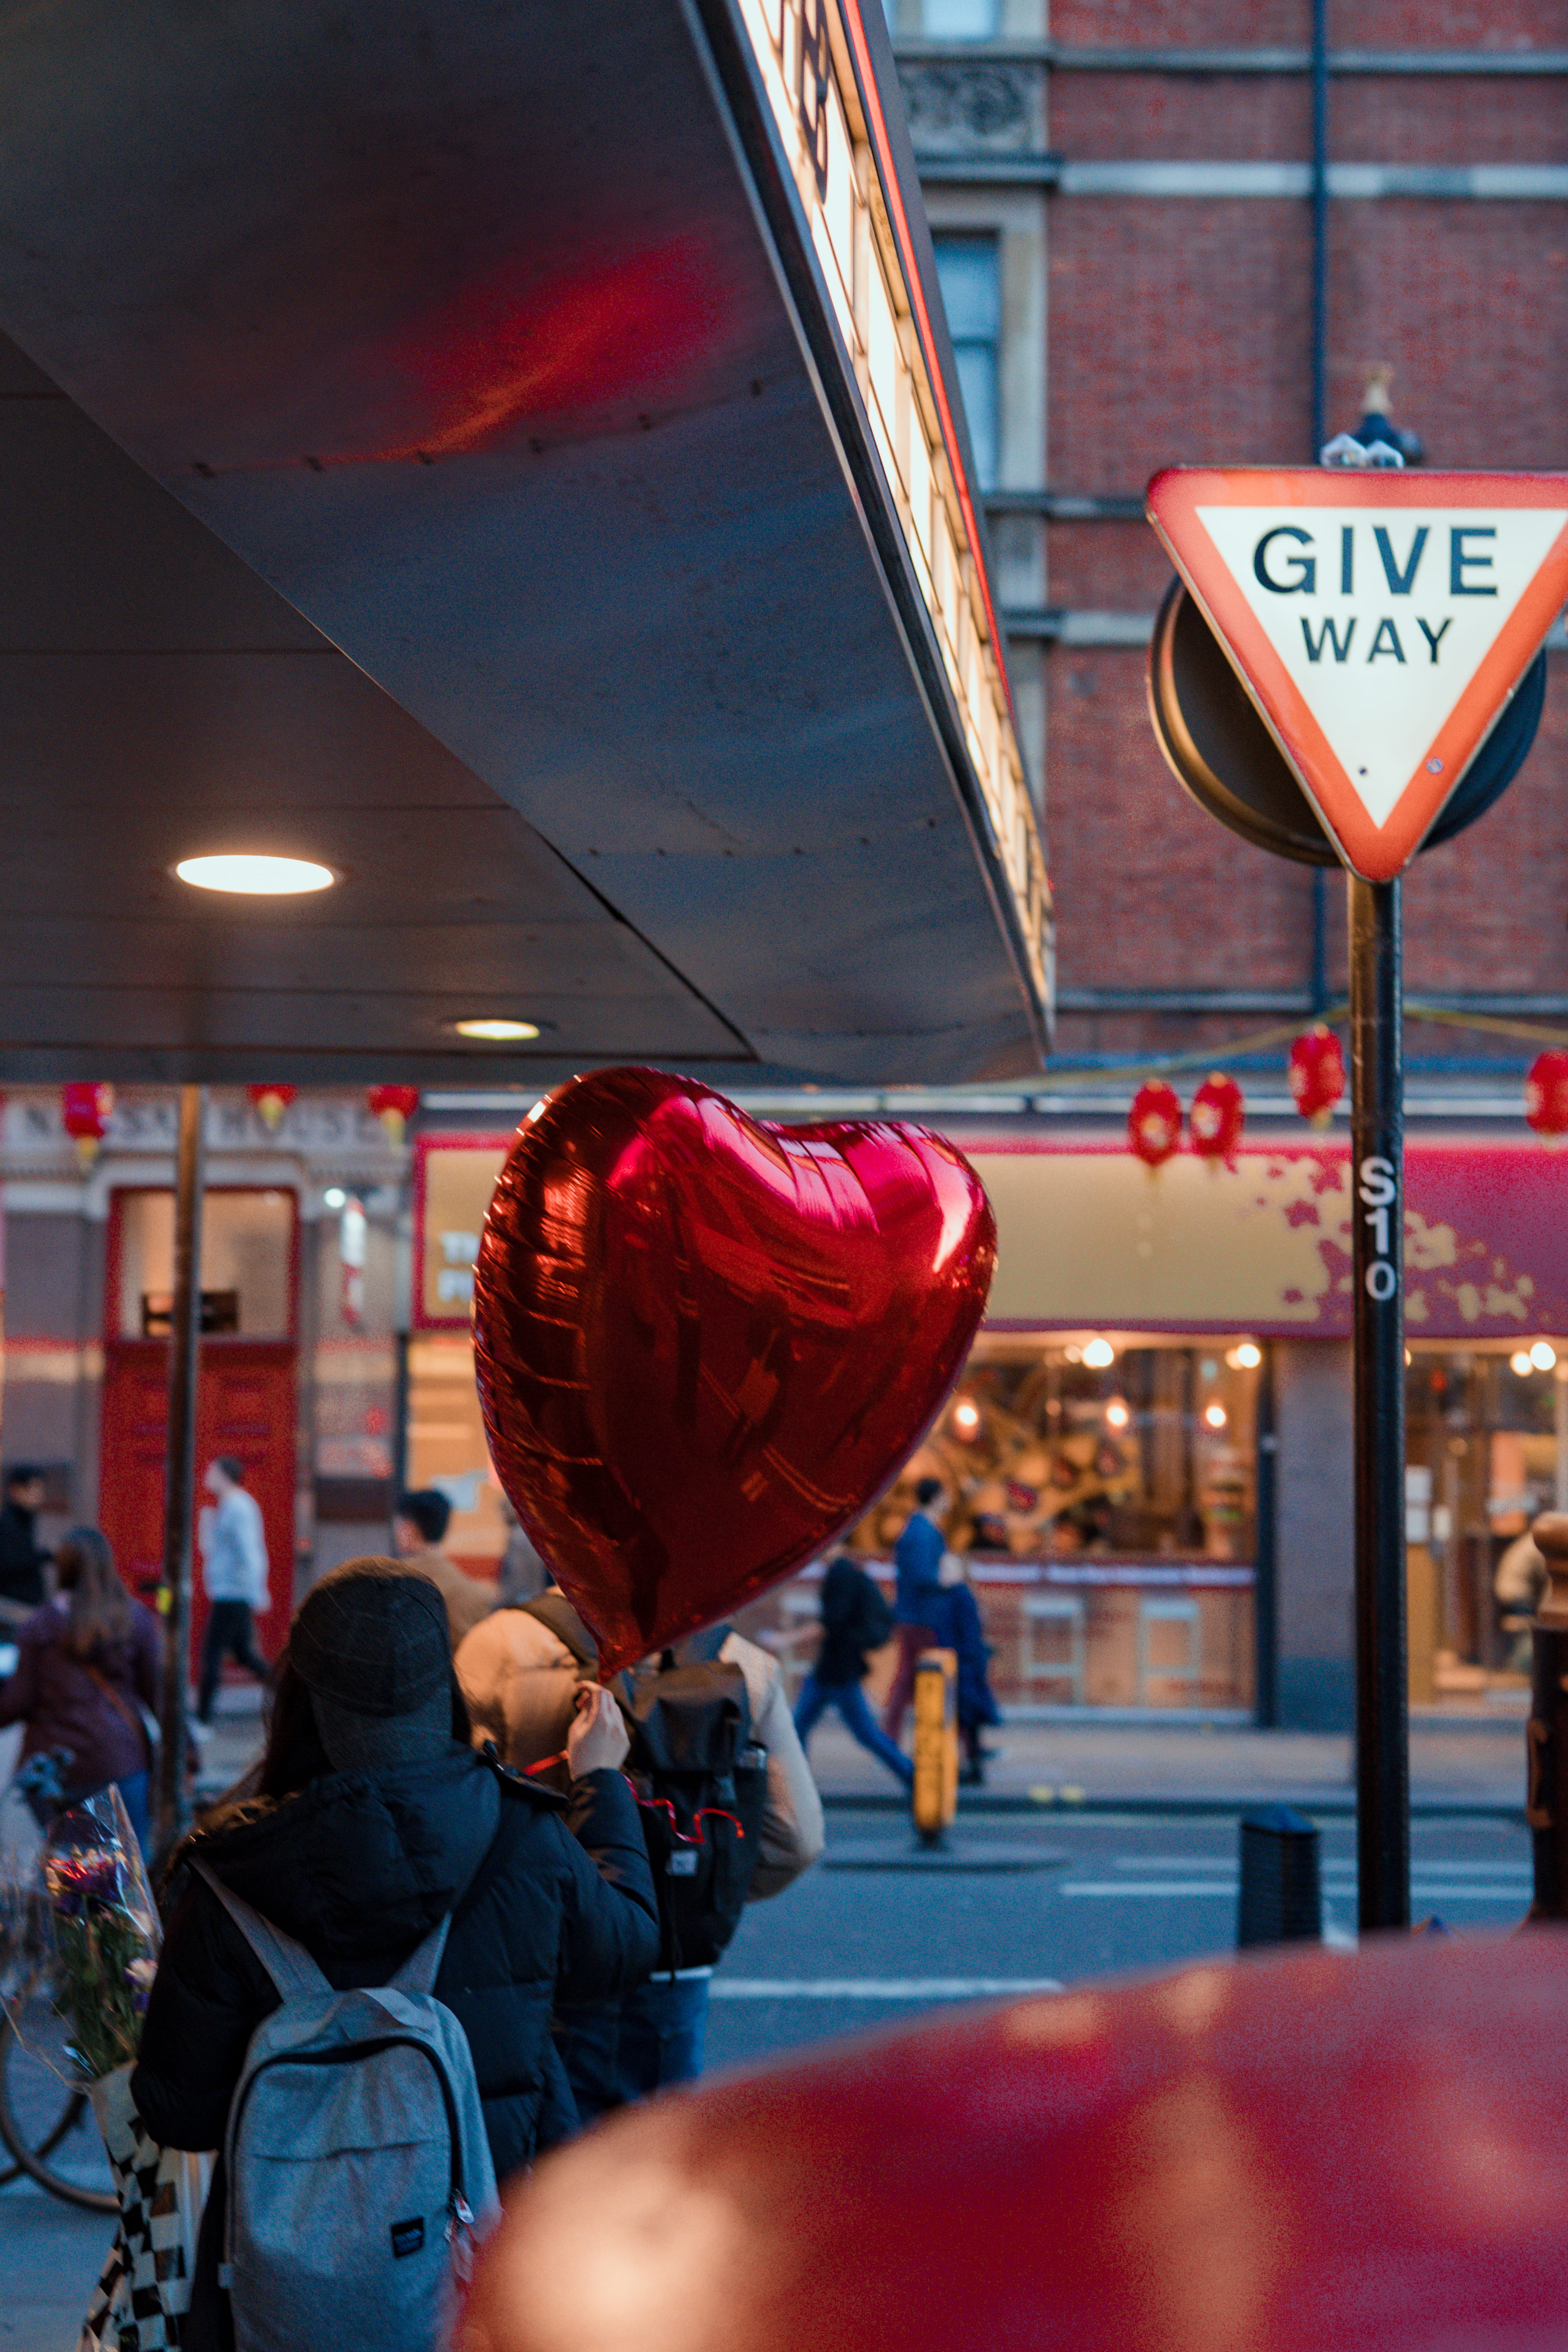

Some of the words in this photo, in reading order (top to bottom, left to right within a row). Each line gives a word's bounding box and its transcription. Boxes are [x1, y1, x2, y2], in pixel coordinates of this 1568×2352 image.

[1253, 525, 1498, 597] GIVE
[1300, 617, 1453, 664] WAY
[1359, 1157, 1396, 1300] S10
